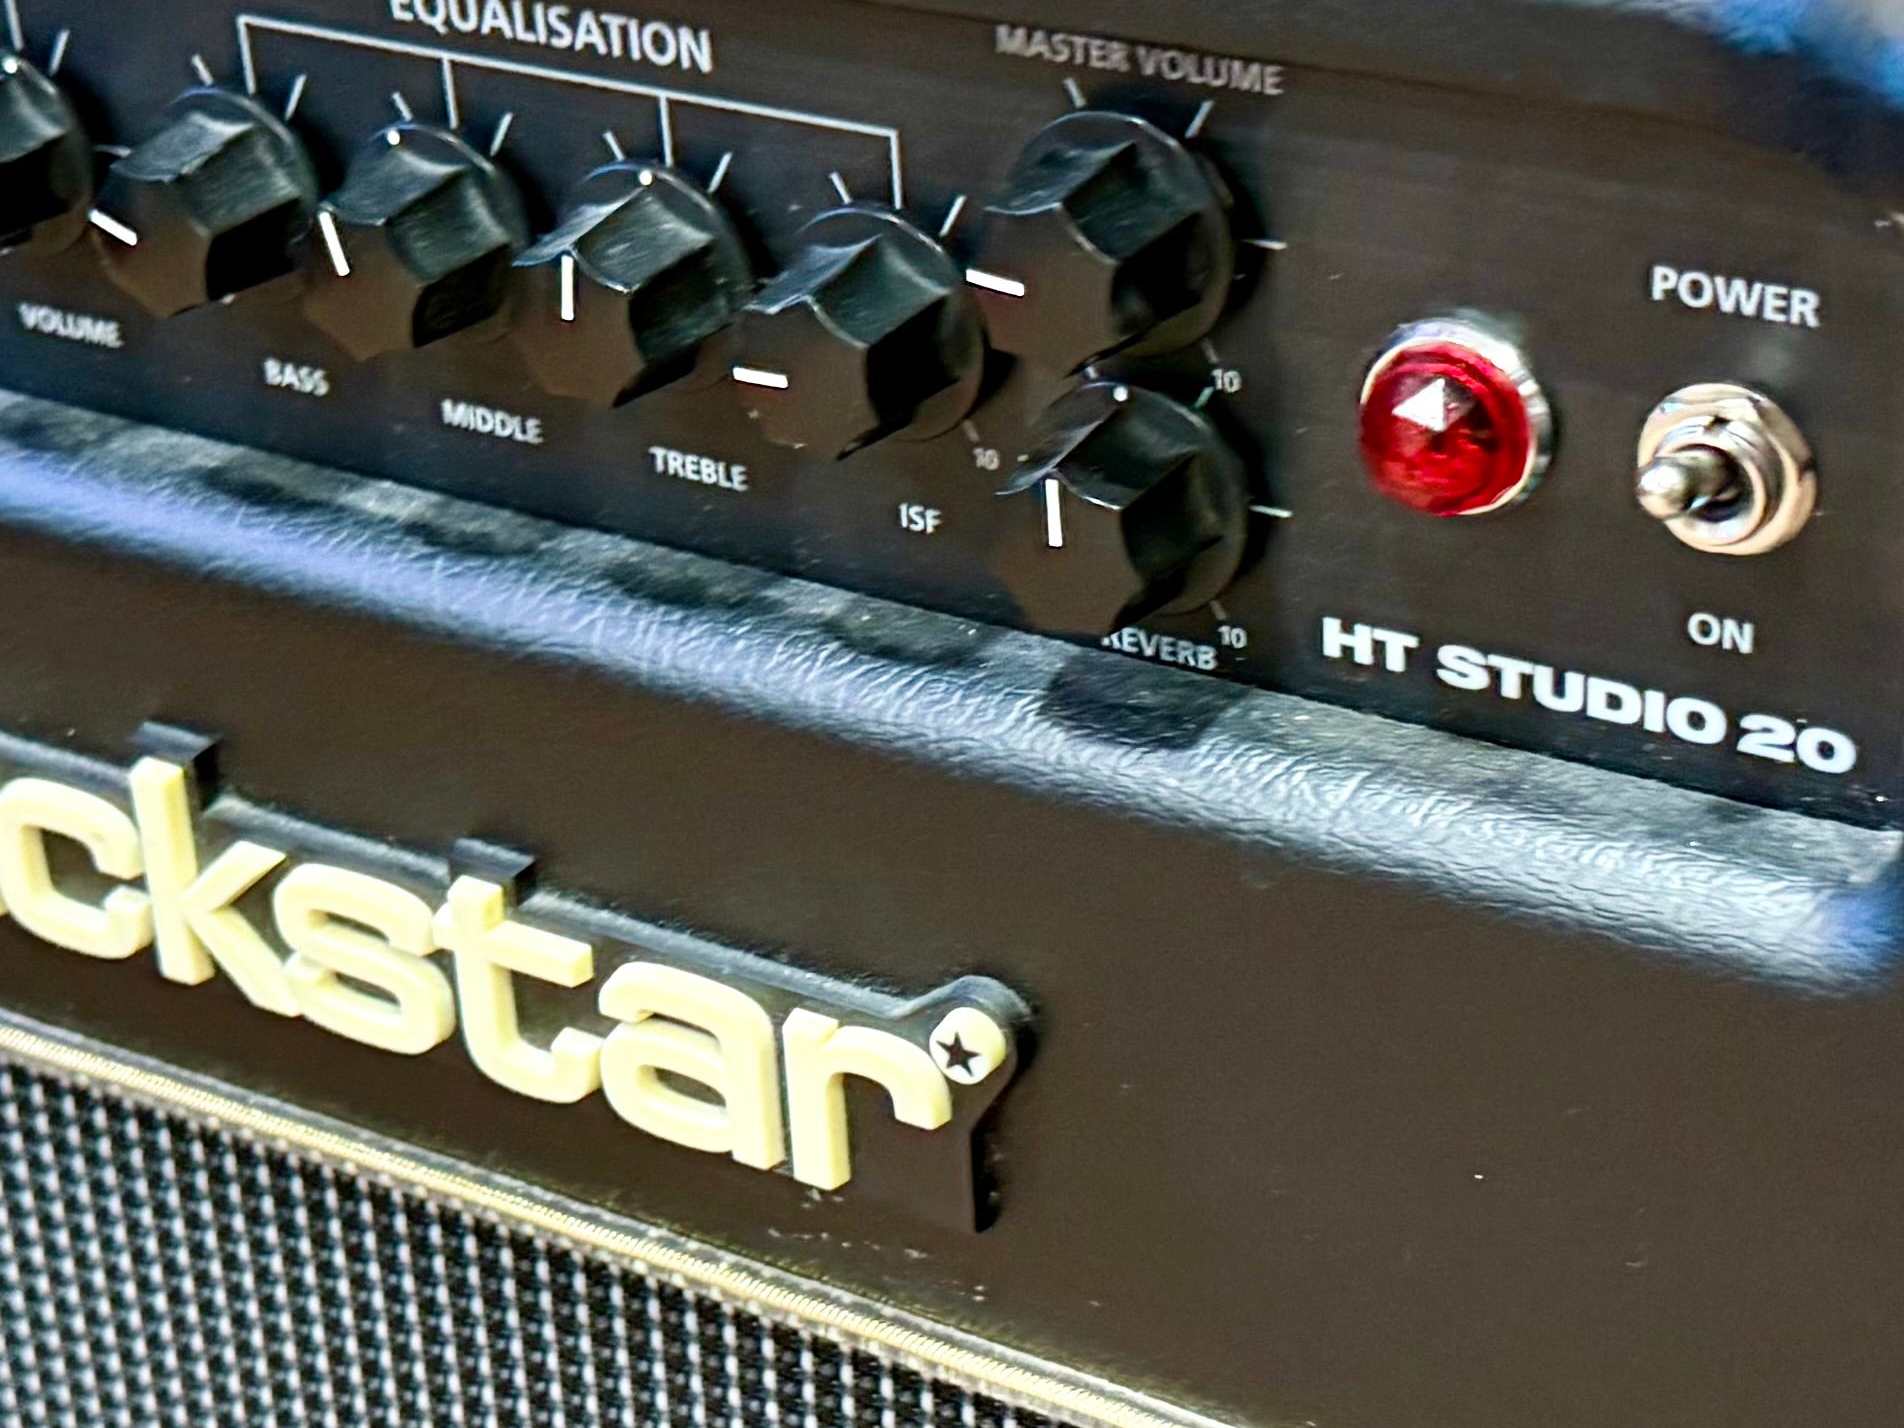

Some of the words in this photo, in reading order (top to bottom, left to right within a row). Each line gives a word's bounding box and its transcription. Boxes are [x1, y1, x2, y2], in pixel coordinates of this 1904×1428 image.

[995, 22, 1130, 73] MASTER
[1137, 45, 1285, 96] VOLUME
[1650, 265, 1821, 328] POWER
[18, 302, 125, 349] VOLUME
[263, 357, 332, 397] BASS
[1210, 369, 1242, 393] 10
[440, 398, 546, 444] MIDDLE
[648, 446, 749, 492] TREBLE
[899, 502, 942, 534] ISF
[1217, 625, 1247, 649] 10
[1688, 611, 1755, 655] ON
[1321, 616, 1420, 673] HT
[1435, 643, 1728, 745] STUDIO
[1736, 712, 1858, 775] 20
